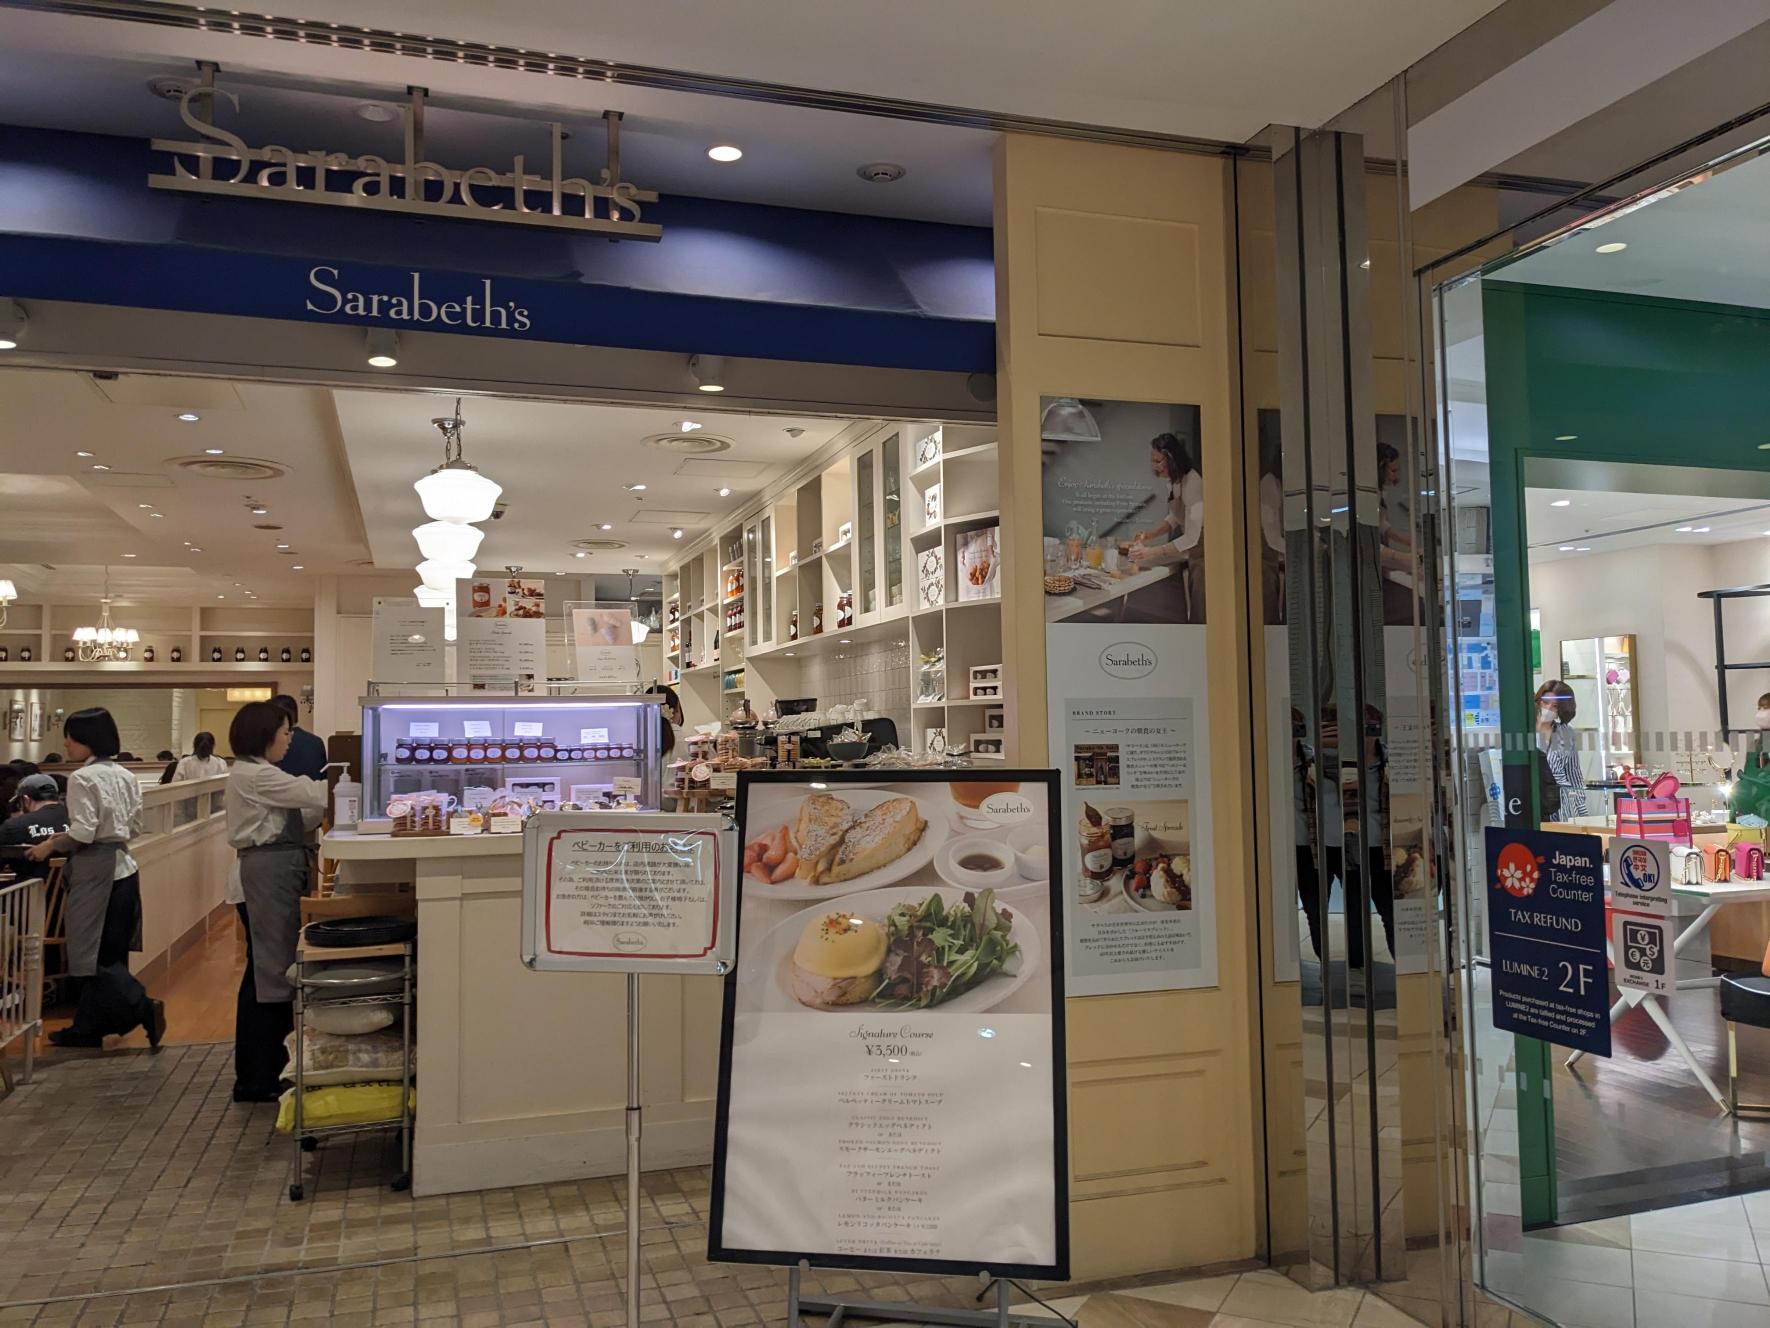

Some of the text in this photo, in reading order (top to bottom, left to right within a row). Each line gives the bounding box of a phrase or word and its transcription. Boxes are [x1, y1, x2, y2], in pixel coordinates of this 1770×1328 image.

[174, 88, 641, 222] Sarabeth's
[306, 266, 531, 332] Sarabeth's
[1105, 653, 1152, 667] Sarabeth's
[986, 802, 1031, 814] Sarabeth's
[28, 824, 55, 838] Los
[1552, 851, 1593, 868] Japan.
[1632, 864, 1648, 872] 中文
[1549, 868, 1594, 886] Tax-free
[1549, 885, 1594, 902] Counter
[1509, 909, 1582, 932] TAX REFUND
[1558, 961, 1593, 995] 2F
[848, 1023, 934, 1040] Signature Course
[1549, 1021, 1571, 1032] Counter
[865, 1044, 908, 1058] ¥3,500
